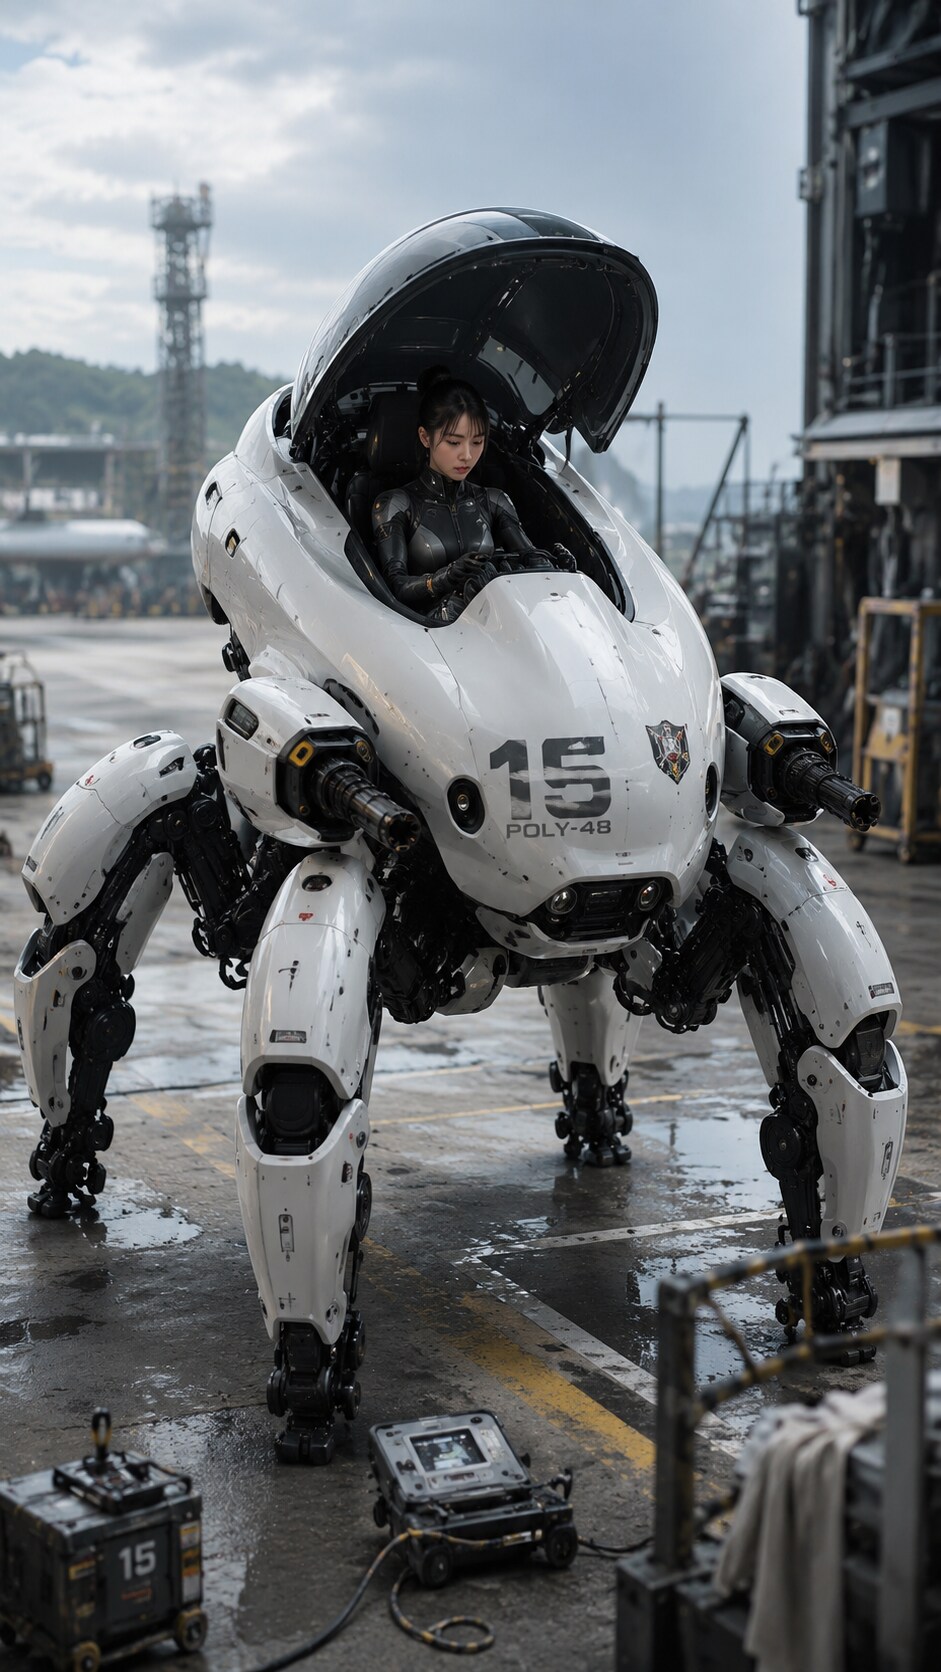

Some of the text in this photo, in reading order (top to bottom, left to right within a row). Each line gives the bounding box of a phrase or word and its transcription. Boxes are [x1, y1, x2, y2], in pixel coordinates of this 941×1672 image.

[489, 736, 612, 820] 15
[506, 820, 612, 839] POLY-48
[119, 1540, 156, 1581] 15
